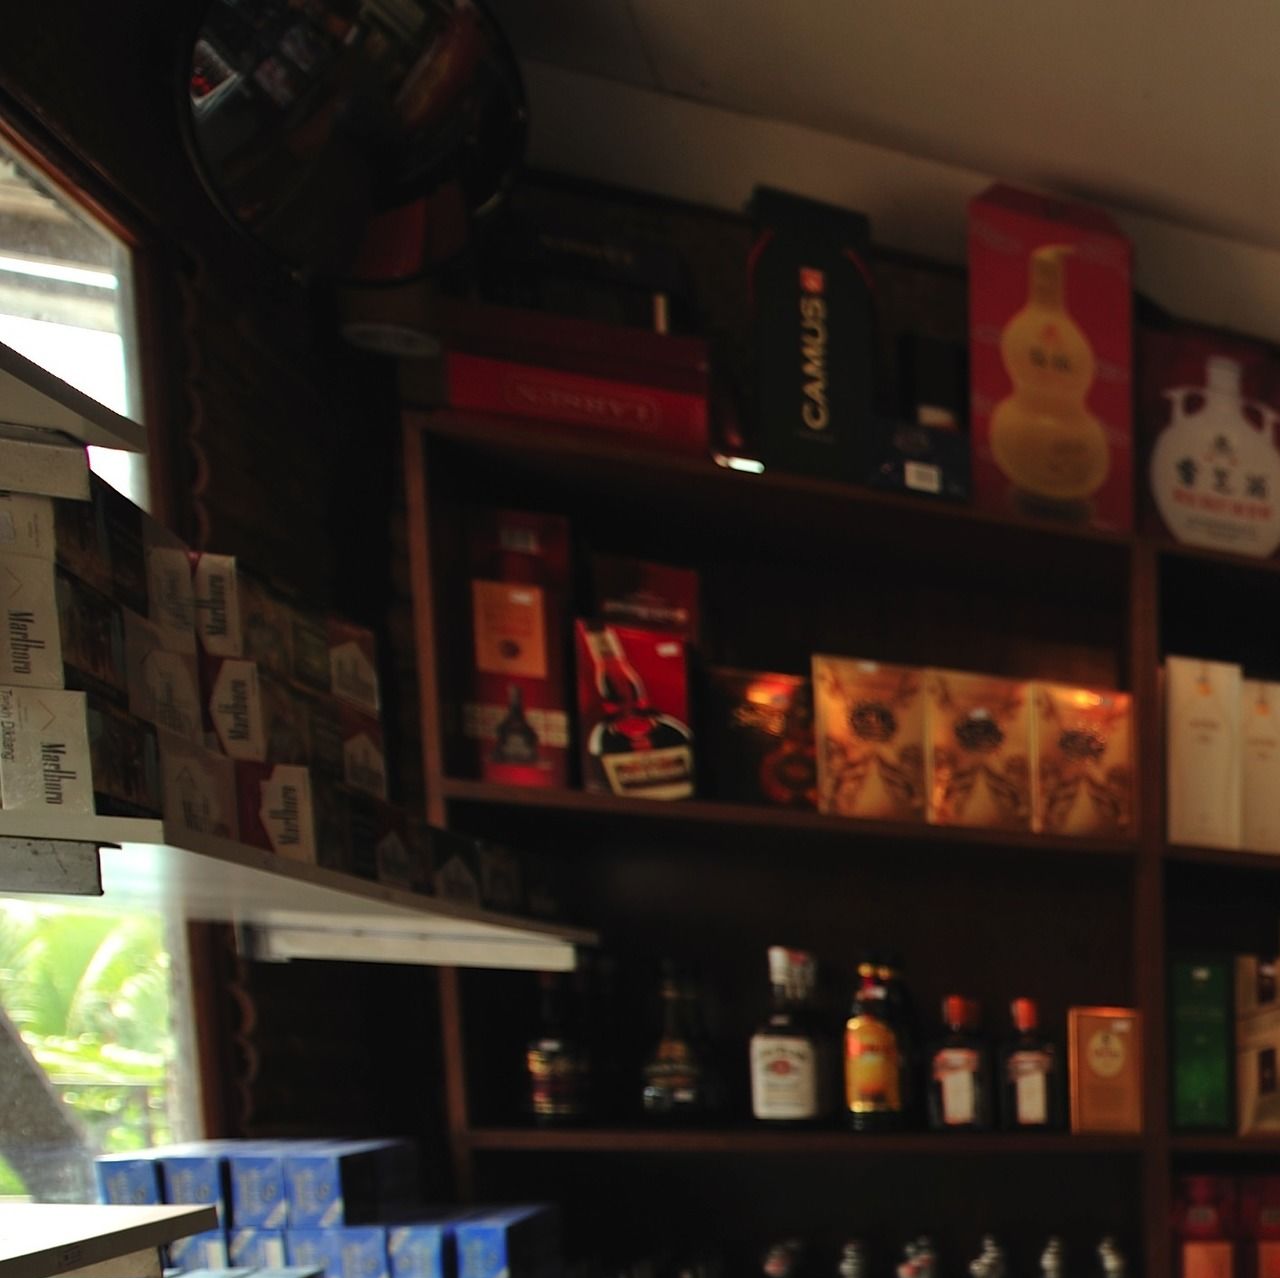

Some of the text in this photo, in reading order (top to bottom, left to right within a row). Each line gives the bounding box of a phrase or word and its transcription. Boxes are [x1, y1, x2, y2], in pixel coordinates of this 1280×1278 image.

[800, 297, 831, 432] CAMUS
[8, 610, 45, 676] Marlboro
[41, 743, 77, 805] Marlboro
